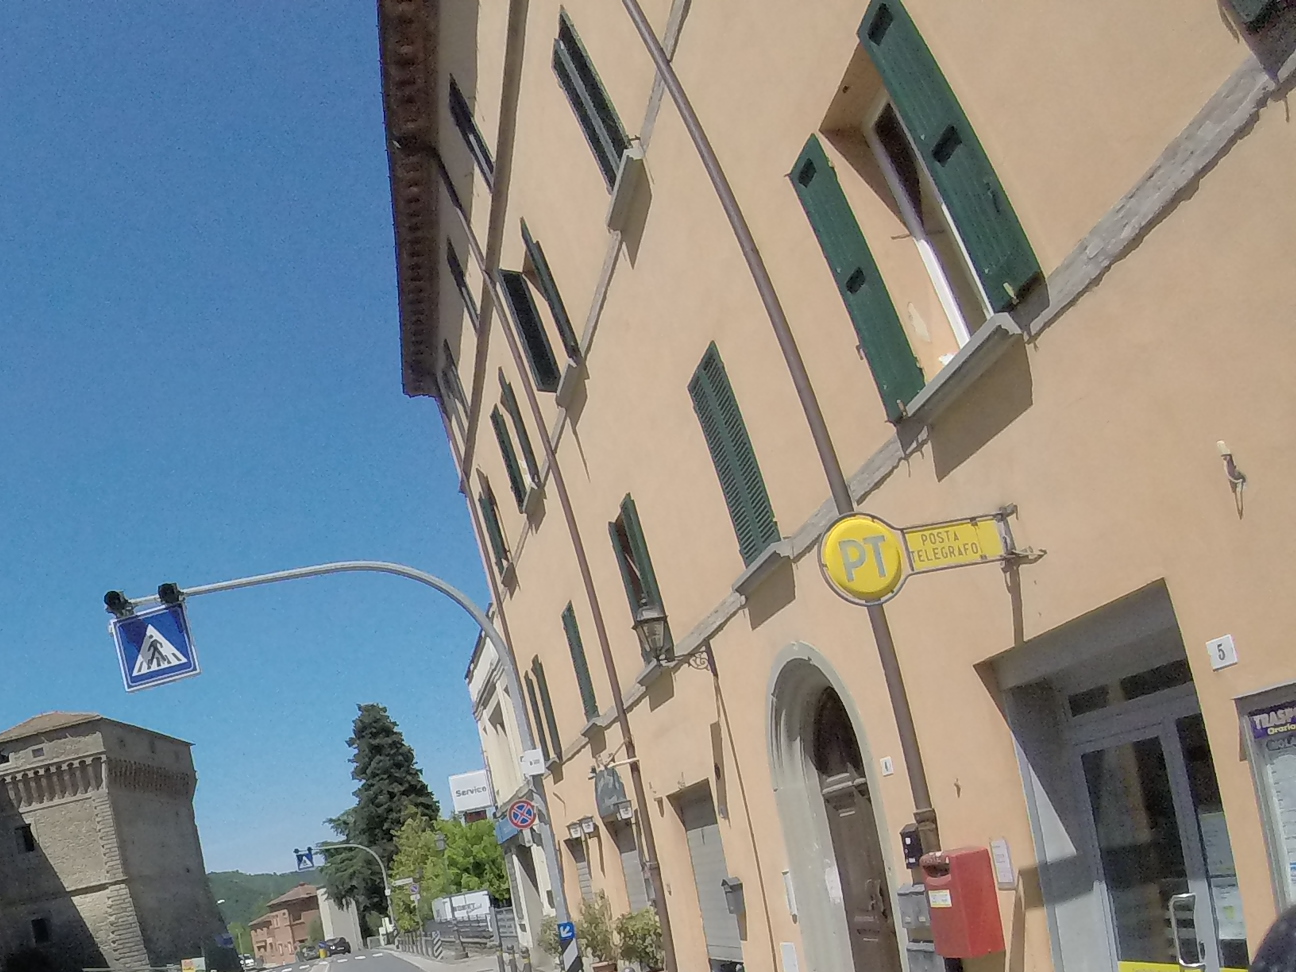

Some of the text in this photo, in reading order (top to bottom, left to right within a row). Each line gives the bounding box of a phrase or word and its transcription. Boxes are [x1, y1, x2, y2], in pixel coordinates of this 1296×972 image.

[920, 530, 960, 547] POSTA
[838, 534, 887, 583] PT
[910, 542, 980, 564] TELEGRAFO
[1216, 643, 1226, 661] 5
[1253, 706, 1296, 730] TRASP
[455, 785, 487, 798] Service
